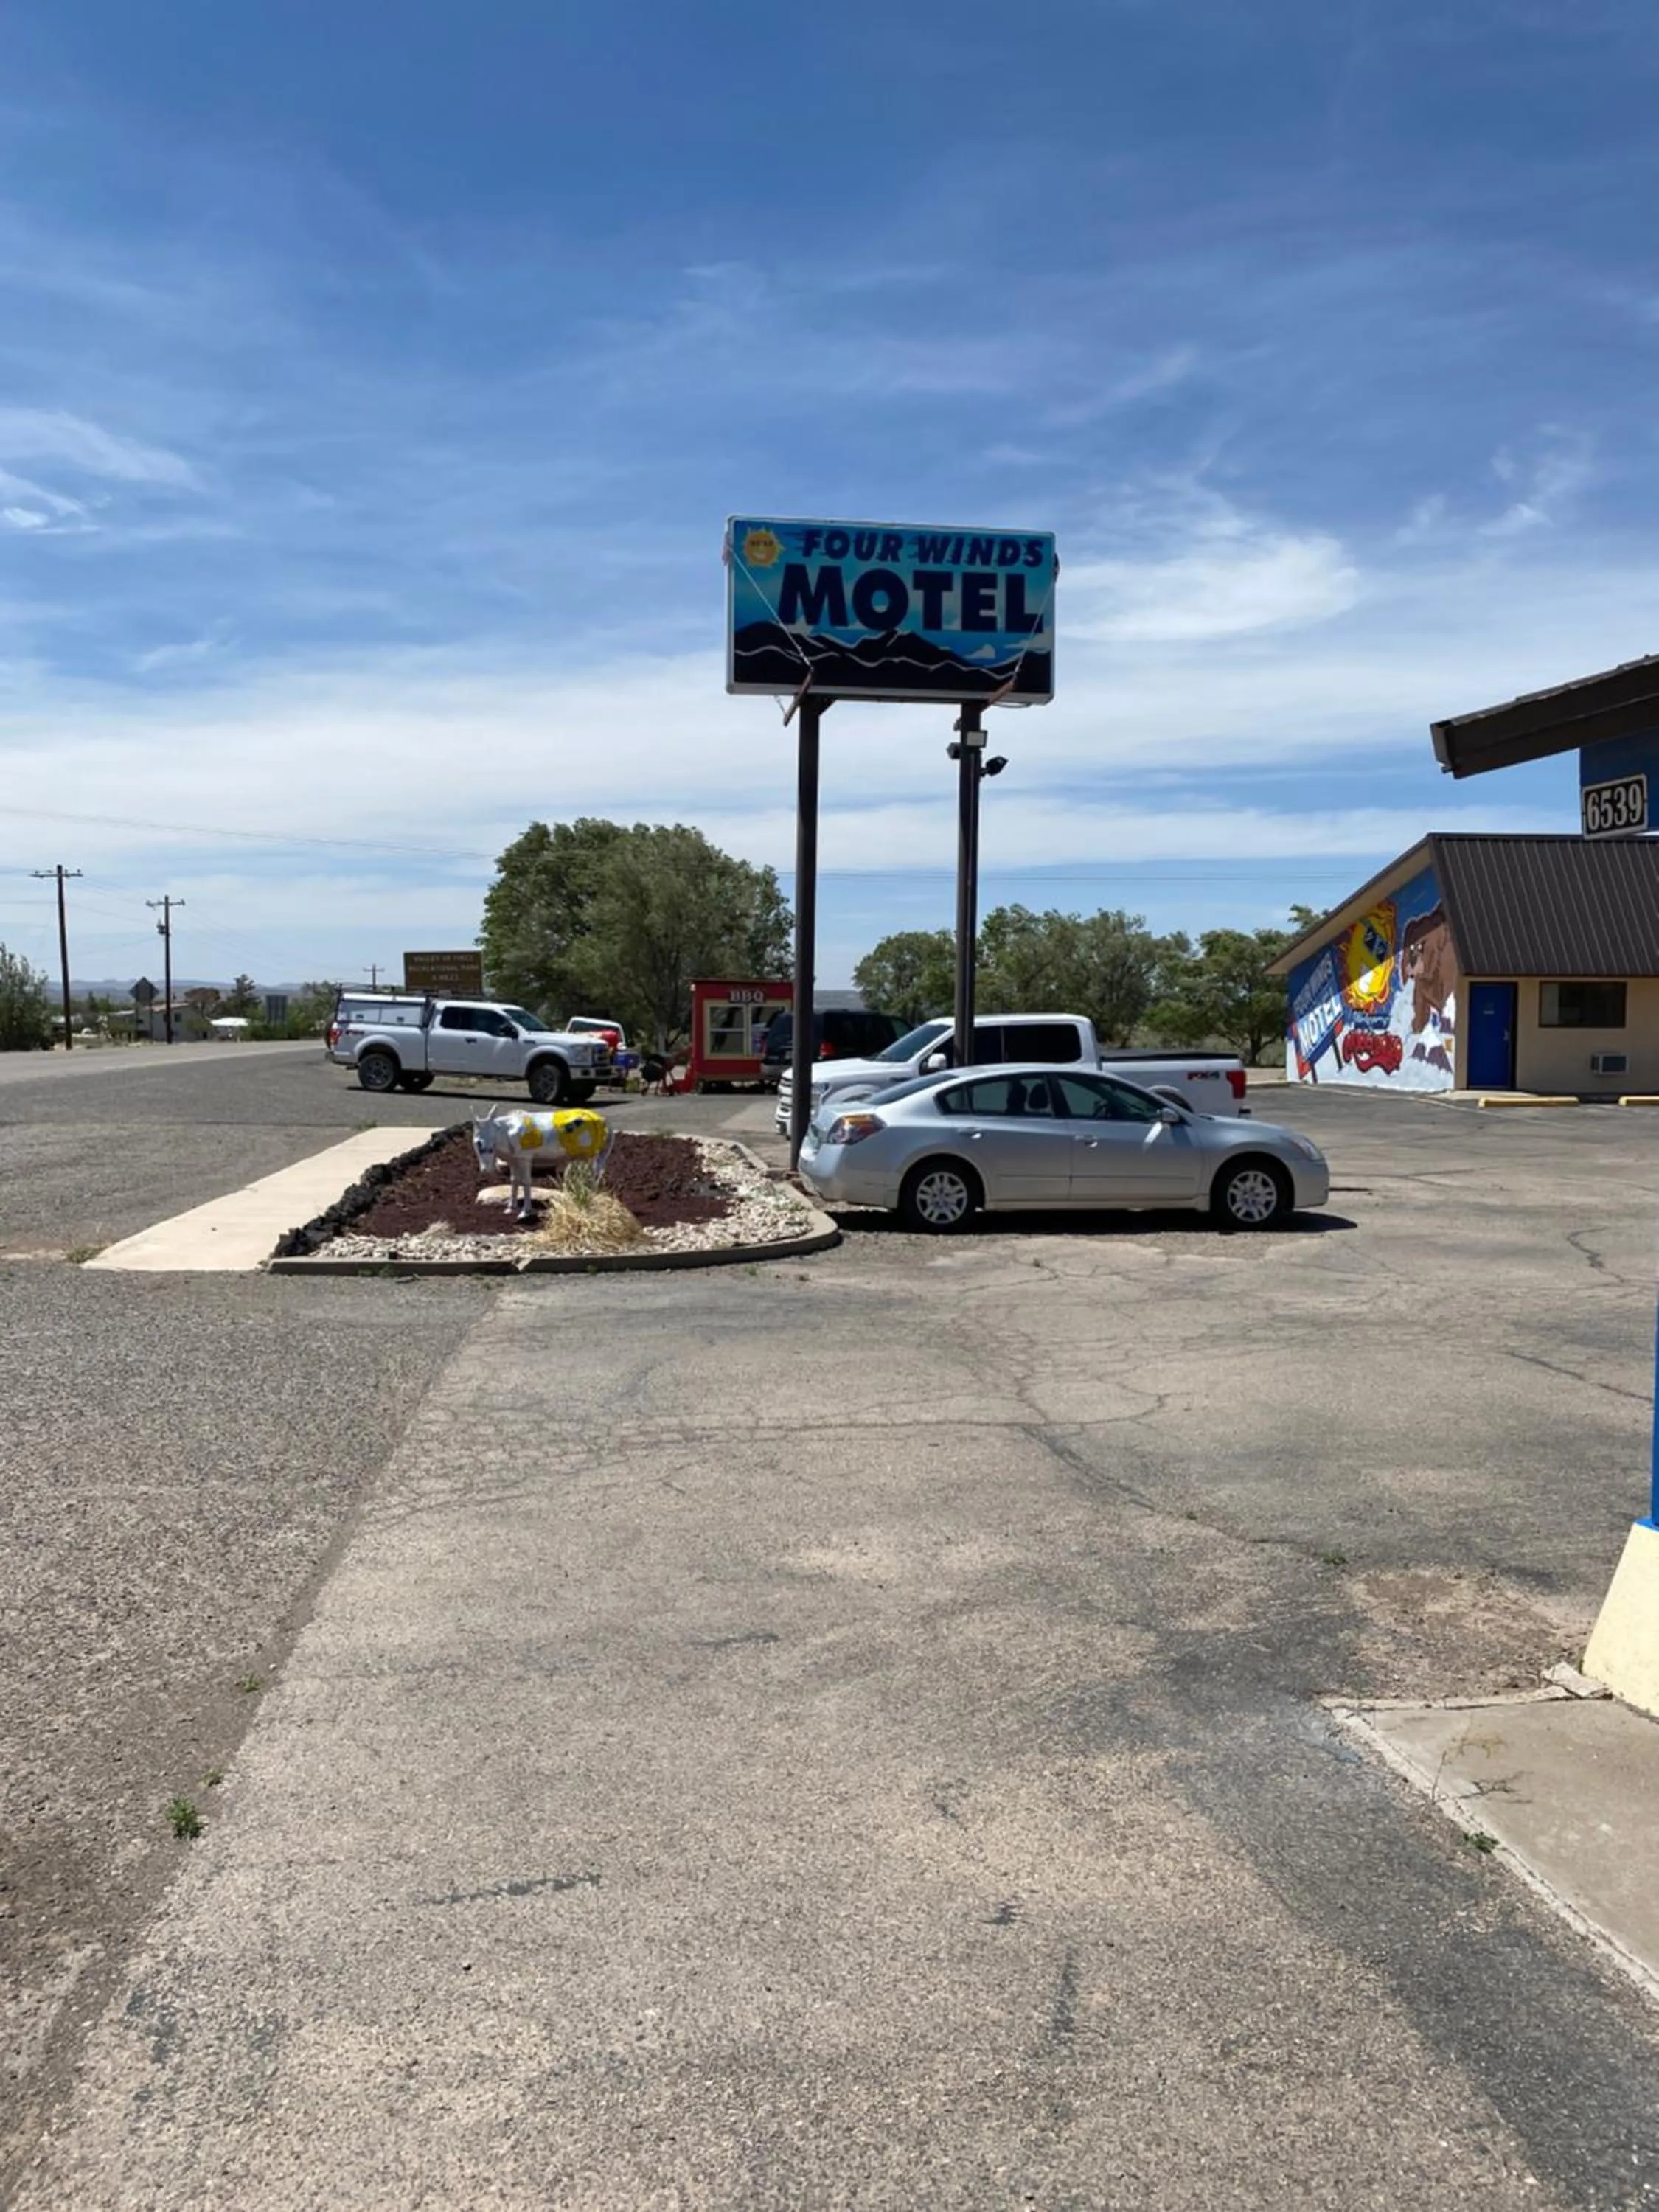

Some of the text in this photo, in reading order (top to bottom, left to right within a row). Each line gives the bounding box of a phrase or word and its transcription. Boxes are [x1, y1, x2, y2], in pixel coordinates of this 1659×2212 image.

[801, 529, 1044, 568] FOUR WINDS
[778, 563, 1043, 633] MOTEL
[1587, 783, 1643, 831] 6539
[729, 990, 765, 1003] BBQ
[1298, 987, 1342, 1056] MOTEL
